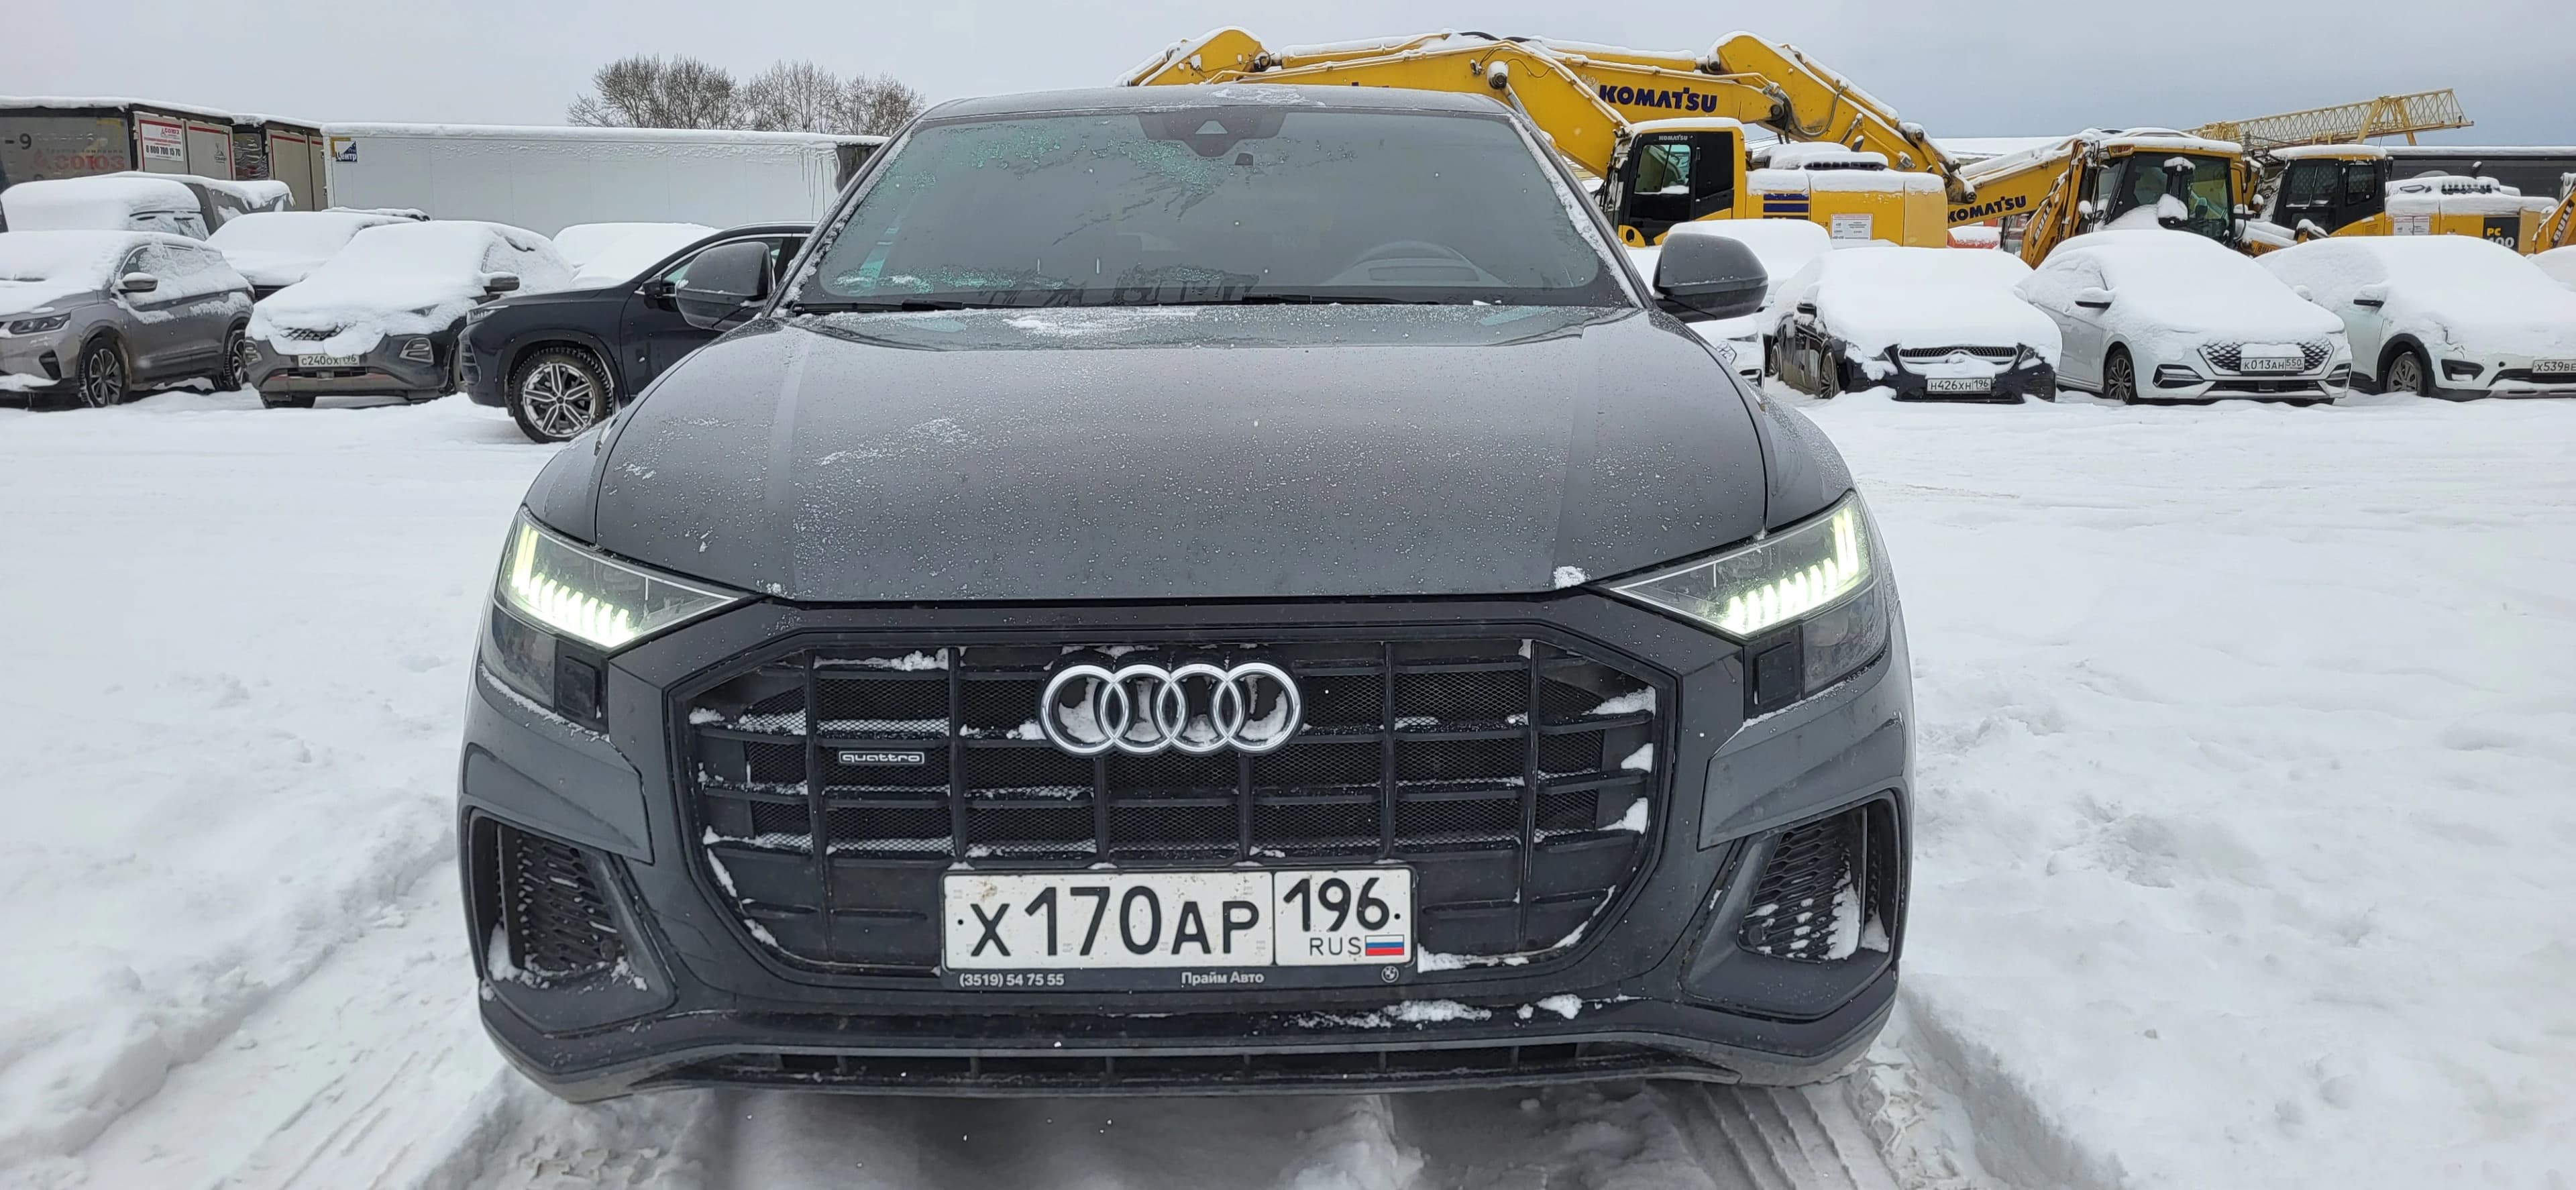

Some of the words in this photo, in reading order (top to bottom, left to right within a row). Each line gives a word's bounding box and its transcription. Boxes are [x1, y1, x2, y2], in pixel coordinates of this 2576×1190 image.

[1599, 85, 1717, 113] KOMATSU
[1947, 195, 2026, 223] KOMATSU
[2034, 205, 2051, 241] BULL
[2487, 227, 2501, 236] PC
[2553, 205, 2573, 241] BULL
[843, 753, 920, 763] quattro
[970, 885, 1259, 957] Х170АР
[1283, 877, 1390, 932] 196
[1310, 936, 1362, 956] RUS
[959, 973, 1004, 987] (3519)
[1006, 973, 1025, 985] 54
[1026, 973, 1046, 985] 75
[1047, 973, 1064, 985] 55
[1182, 972, 1227, 987] Прайм
[1230, 973, 1264, 983] Авто
